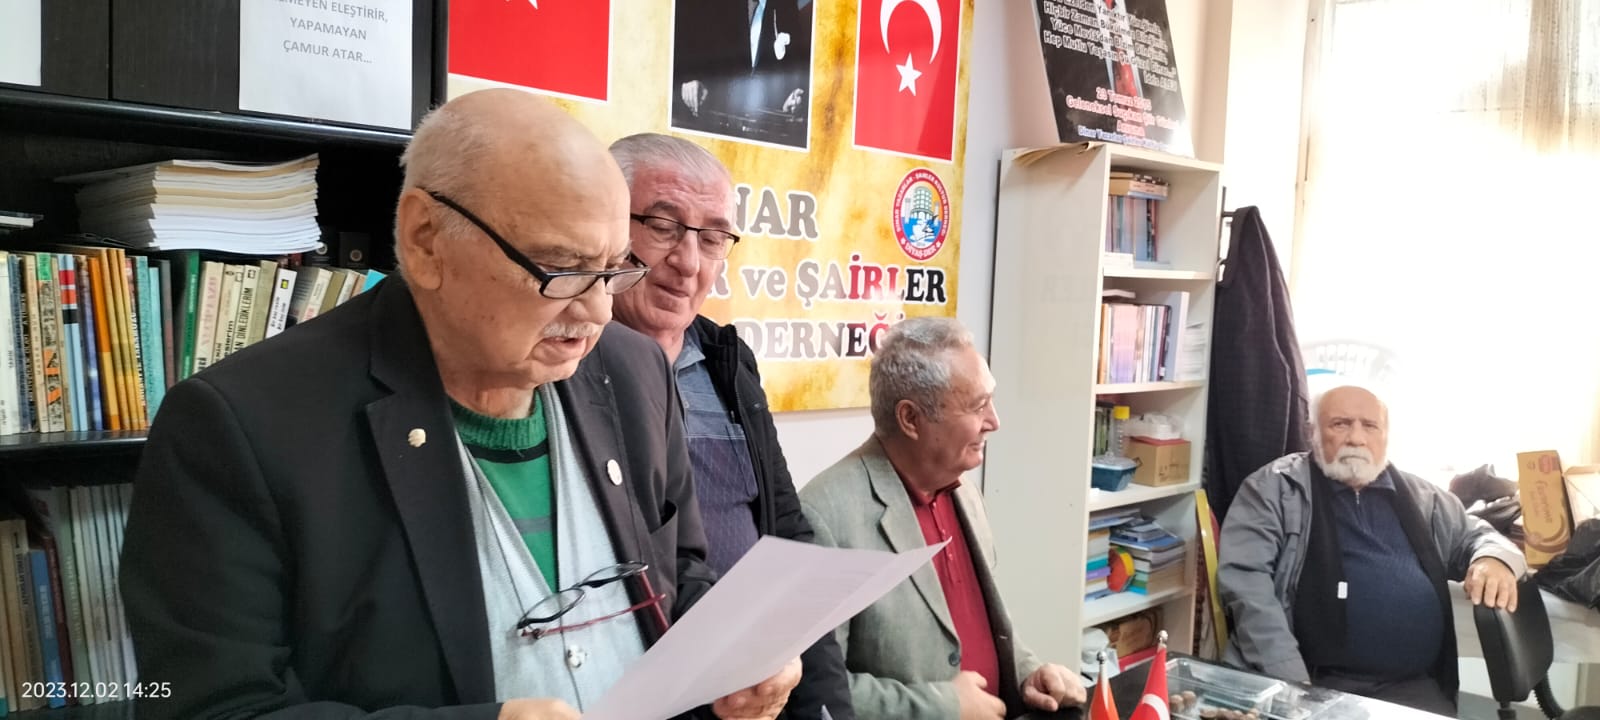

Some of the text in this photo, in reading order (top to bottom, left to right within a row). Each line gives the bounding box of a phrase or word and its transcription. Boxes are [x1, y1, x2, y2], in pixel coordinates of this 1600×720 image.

[331, 1, 388, 23] ELEŞTİRİR,
[1071, 8, 1099, 28] Zaman
[290, 17, 367, 40] YAPAMAYAN
[1043, 30, 1062, 48] Hep
[283, 40, 372, 64] ÇAMUR ATAR...
[742, 268, 786, 296] ve
[796, 255, 946, 307] ŞAİRLER
[239, 287, 252, 340] DİNLEDİKLERİM
[735, 312, 905, 358] DERNEĞ
